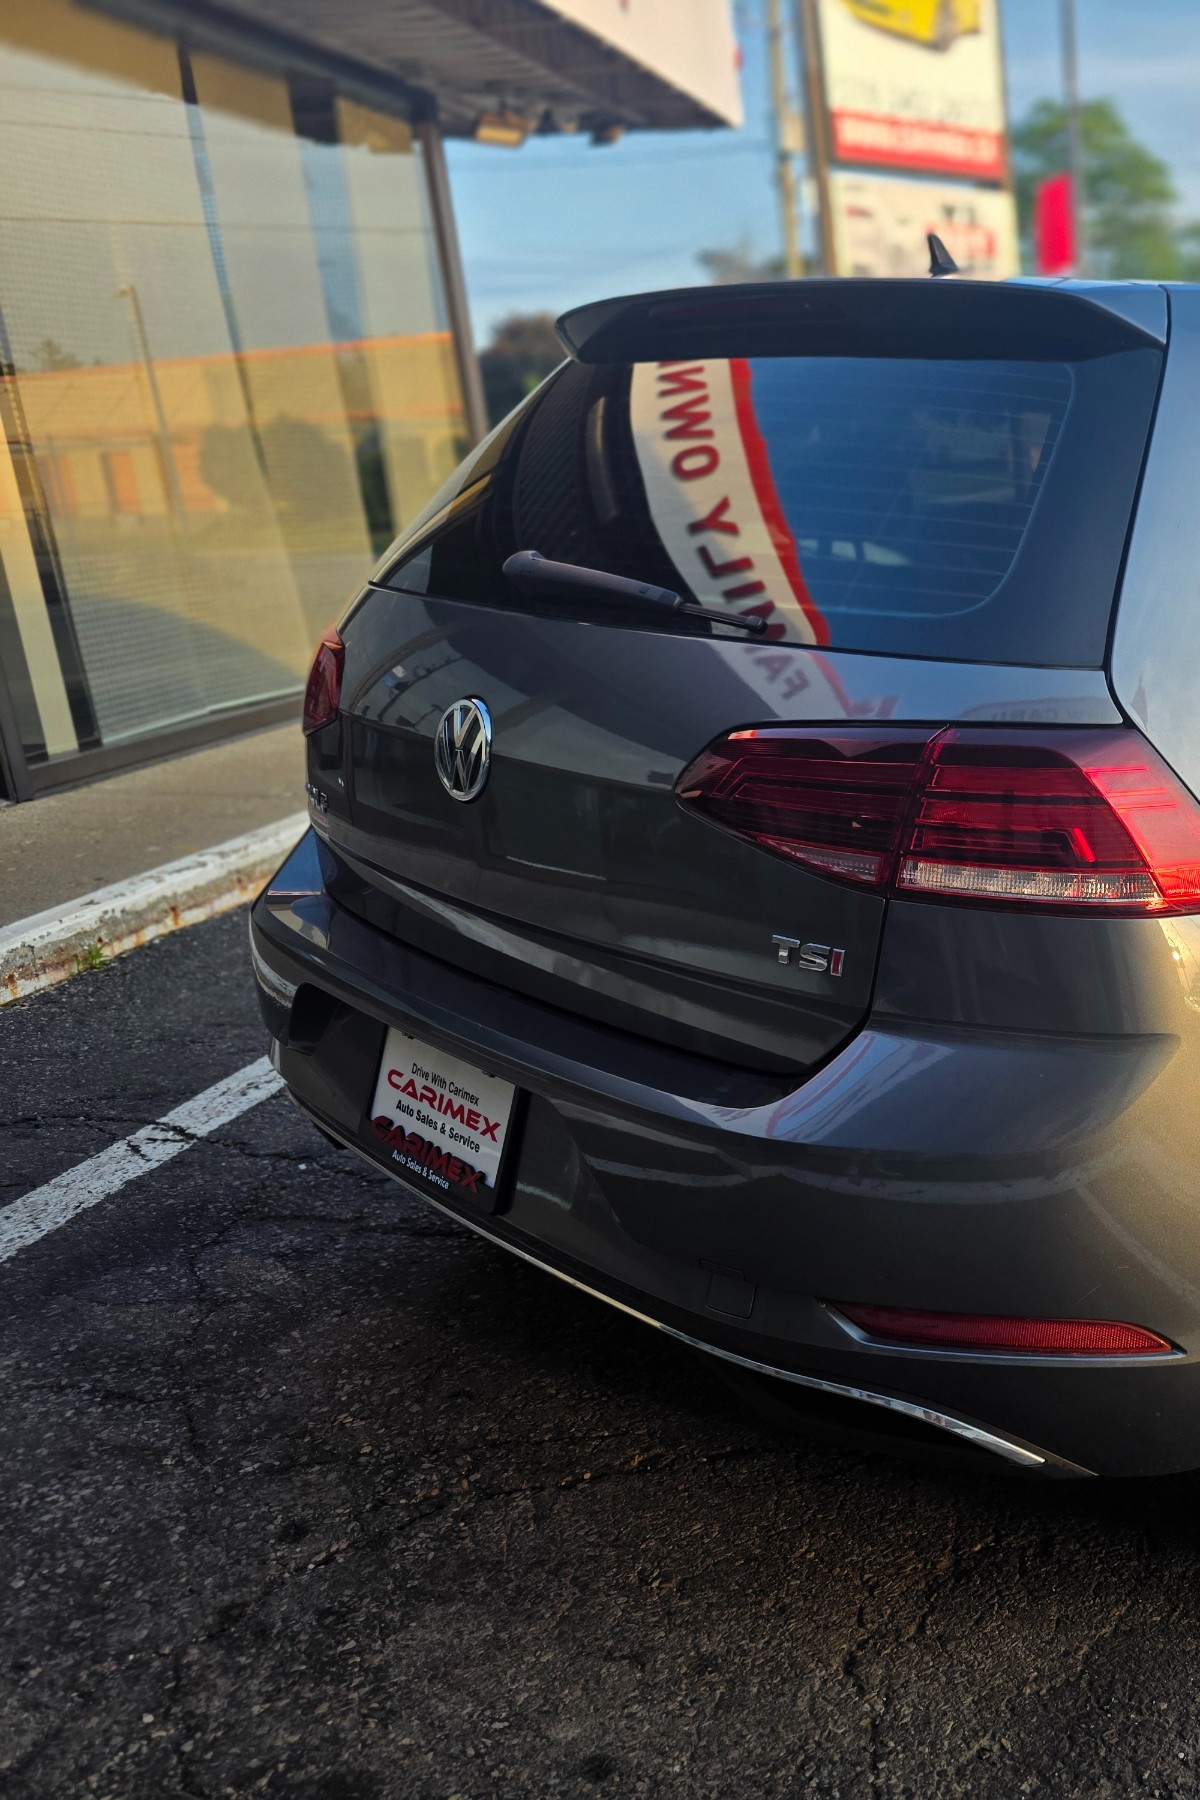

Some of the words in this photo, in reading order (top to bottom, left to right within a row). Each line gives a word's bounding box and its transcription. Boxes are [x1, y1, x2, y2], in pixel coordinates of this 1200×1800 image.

[771, 934, 846, 977] TSI
[387, 1068, 501, 1143] CARIMEX
[411, 1063, 430, 1081] Drive
[431, 1071, 447, 1090] With
[448, 1081, 480, 1106] Carimex
[396, 1099, 414, 1118] Auto
[415, 1110, 438, 1131] Sales
[439, 1122, 446, 1135] &
[448, 1127, 480, 1153] Service
[370, 1115, 484, 1194] CARIMEX
[391, 1150, 407, 1165] Auto
[406, 1157, 422, 1175] Sales
[422, 1165, 428, 1178] &
[428, 1169, 450, 1190] Service
